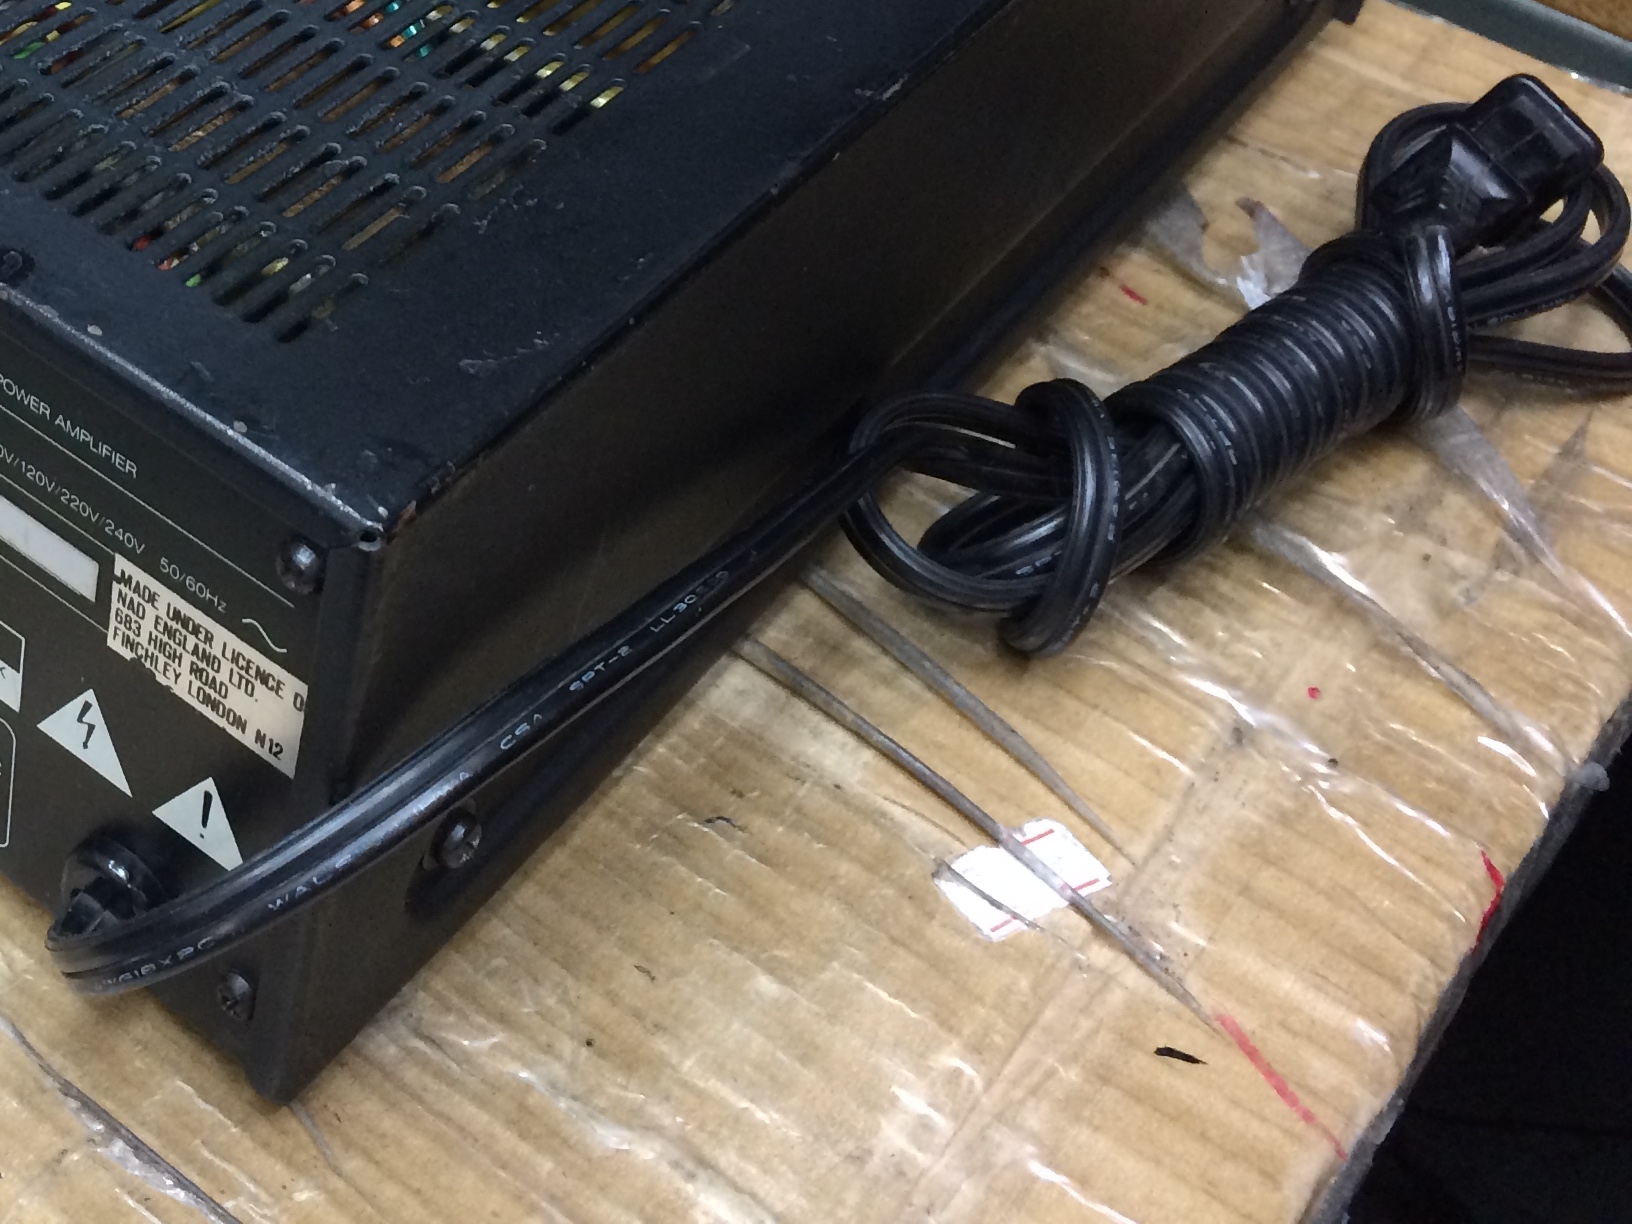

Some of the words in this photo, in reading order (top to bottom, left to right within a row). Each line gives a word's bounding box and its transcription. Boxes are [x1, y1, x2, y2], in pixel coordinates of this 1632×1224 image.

[54, 414, 138, 479] AMPLIFIER
[119, 569, 160, 611] MADE
[166, 602, 215, 649] UNDER
[222, 641, 286, 700] LICENCE
[159, 556, 228, 614] 50/60Hz
[112, 625, 182, 686] FINCHLEY
[187, 679, 248, 735] LONDON
[255, 728, 285, 761] N12
[114, 607, 142, 638] 683
[148, 630, 183, 669] HIGH
[189, 659, 229, 700] ROAD
[117, 588, 146, 621] NAD
[154, 614, 222, 674] ENGLAND
[229, 667, 258, 703] LTD.
